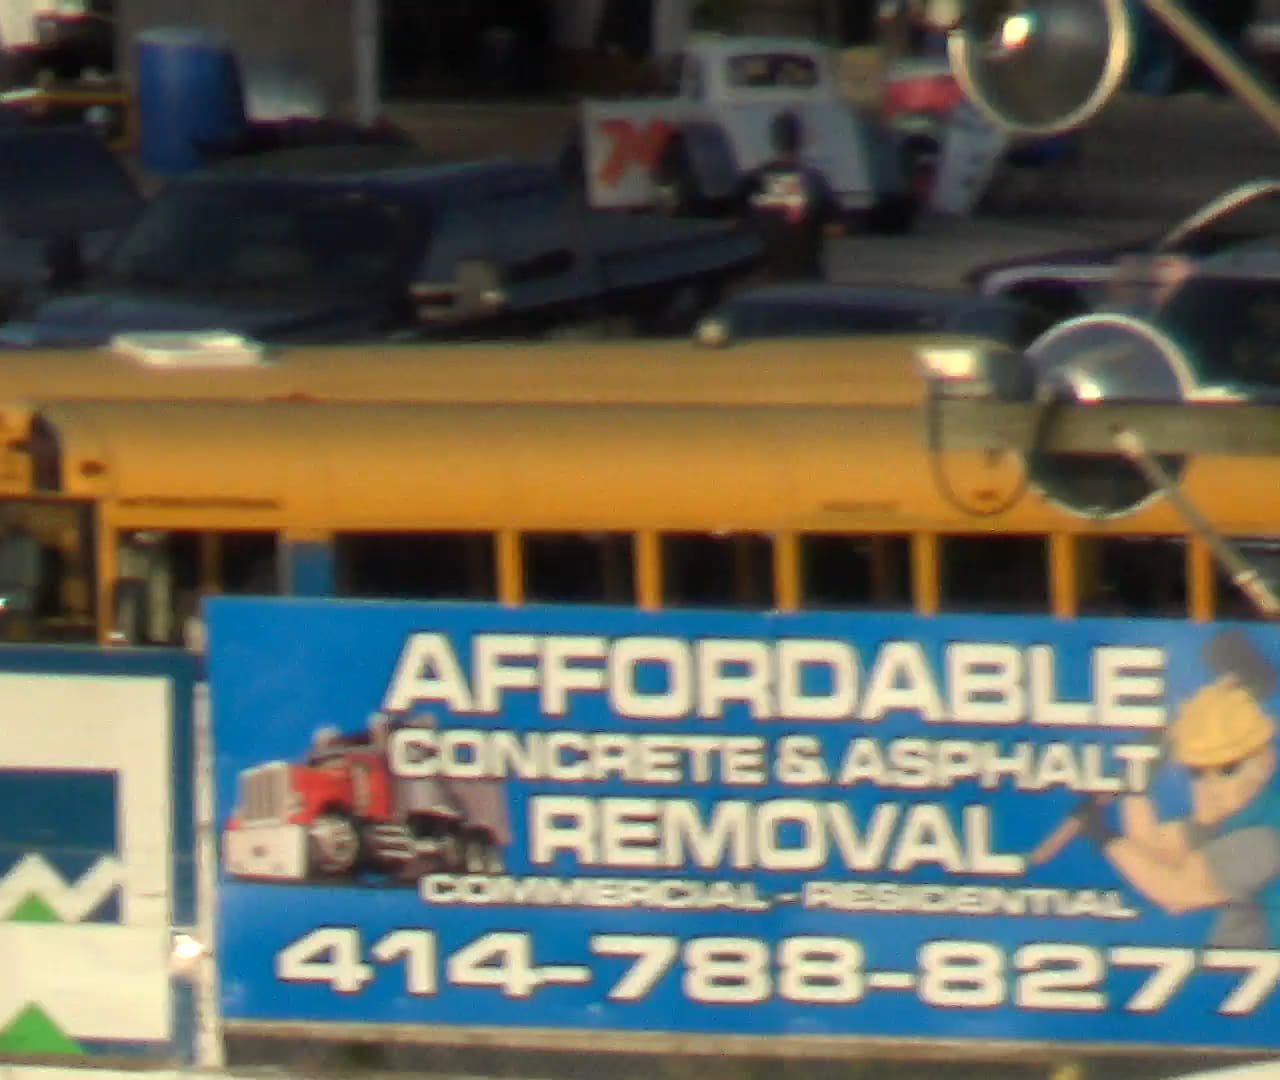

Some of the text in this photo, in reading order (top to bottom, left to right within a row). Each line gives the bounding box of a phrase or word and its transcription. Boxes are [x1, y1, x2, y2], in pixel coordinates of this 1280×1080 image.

[382, 631, 1169, 729] AFFORDABLE
[388, 726, 1163, 794] CONCRETE & ASPHALT
[529, 795, 1026, 876] REMOVAL
[422, 872, 771, 911] COMMERCIAL
[801, 877, 1142, 919] RESIDENTIAL
[275, 924, 1280, 1018] 414-788-8277
